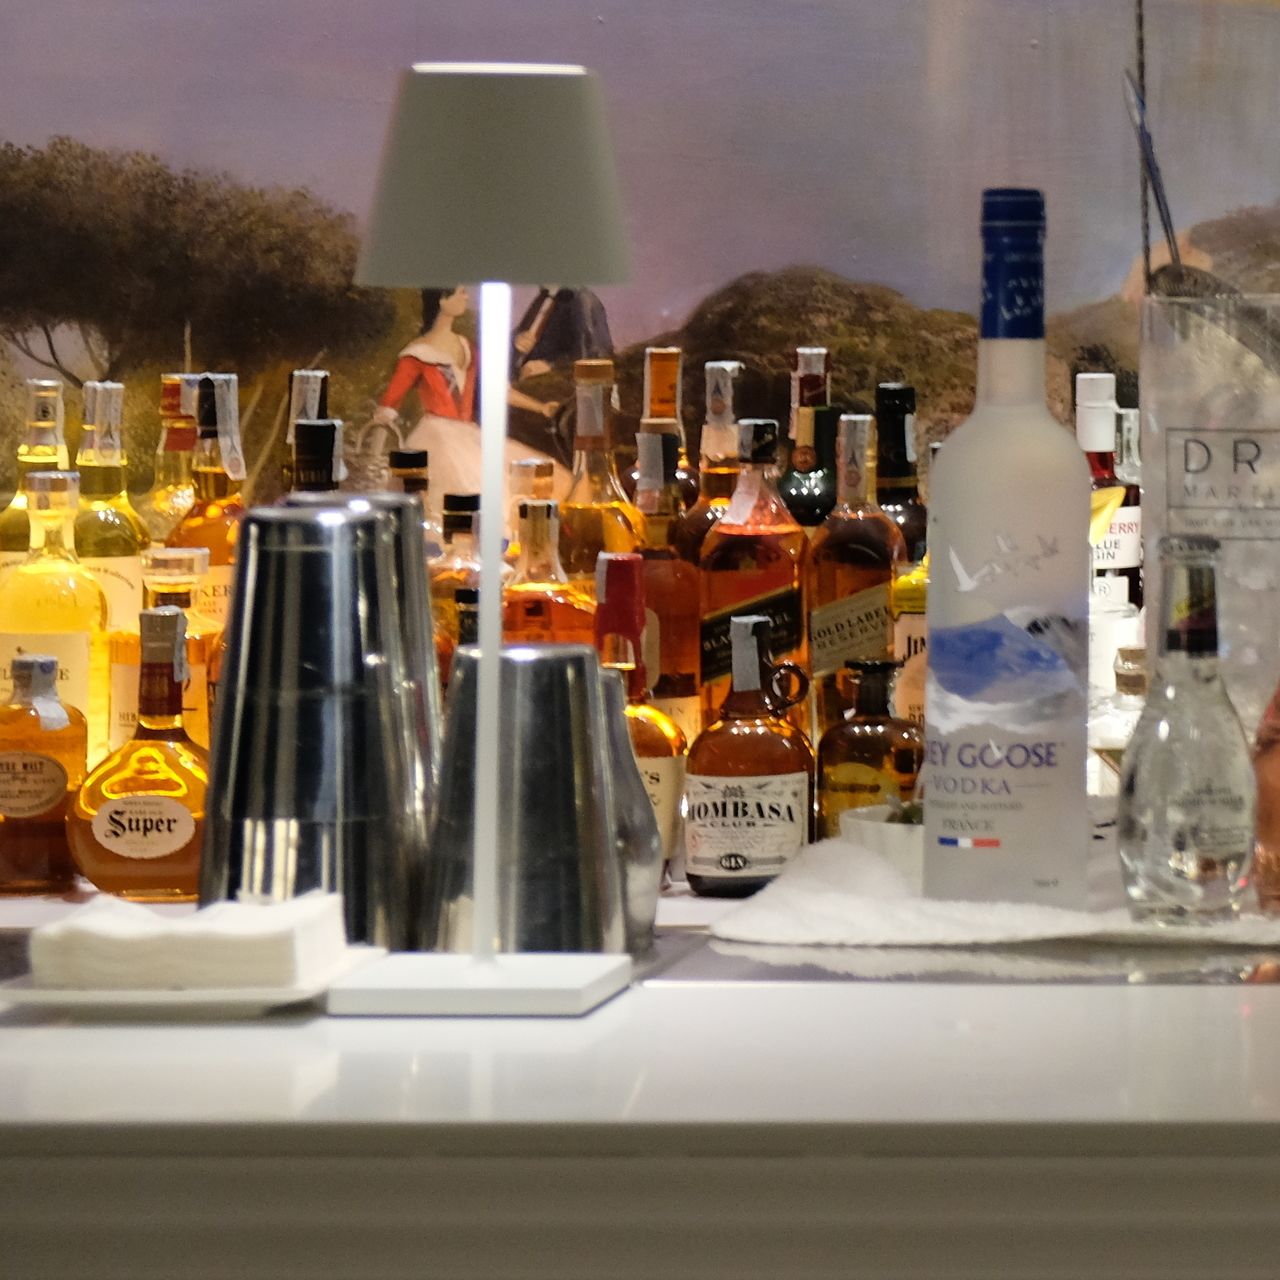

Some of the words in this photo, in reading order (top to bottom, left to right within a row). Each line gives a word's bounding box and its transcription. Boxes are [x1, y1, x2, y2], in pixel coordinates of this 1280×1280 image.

[1107, 521, 1140, 535] ERRY
[957, 741, 1058, 769] GOOSE
[931, 775, 1012, 795] VODKA
[104, 809, 178, 839] Super
